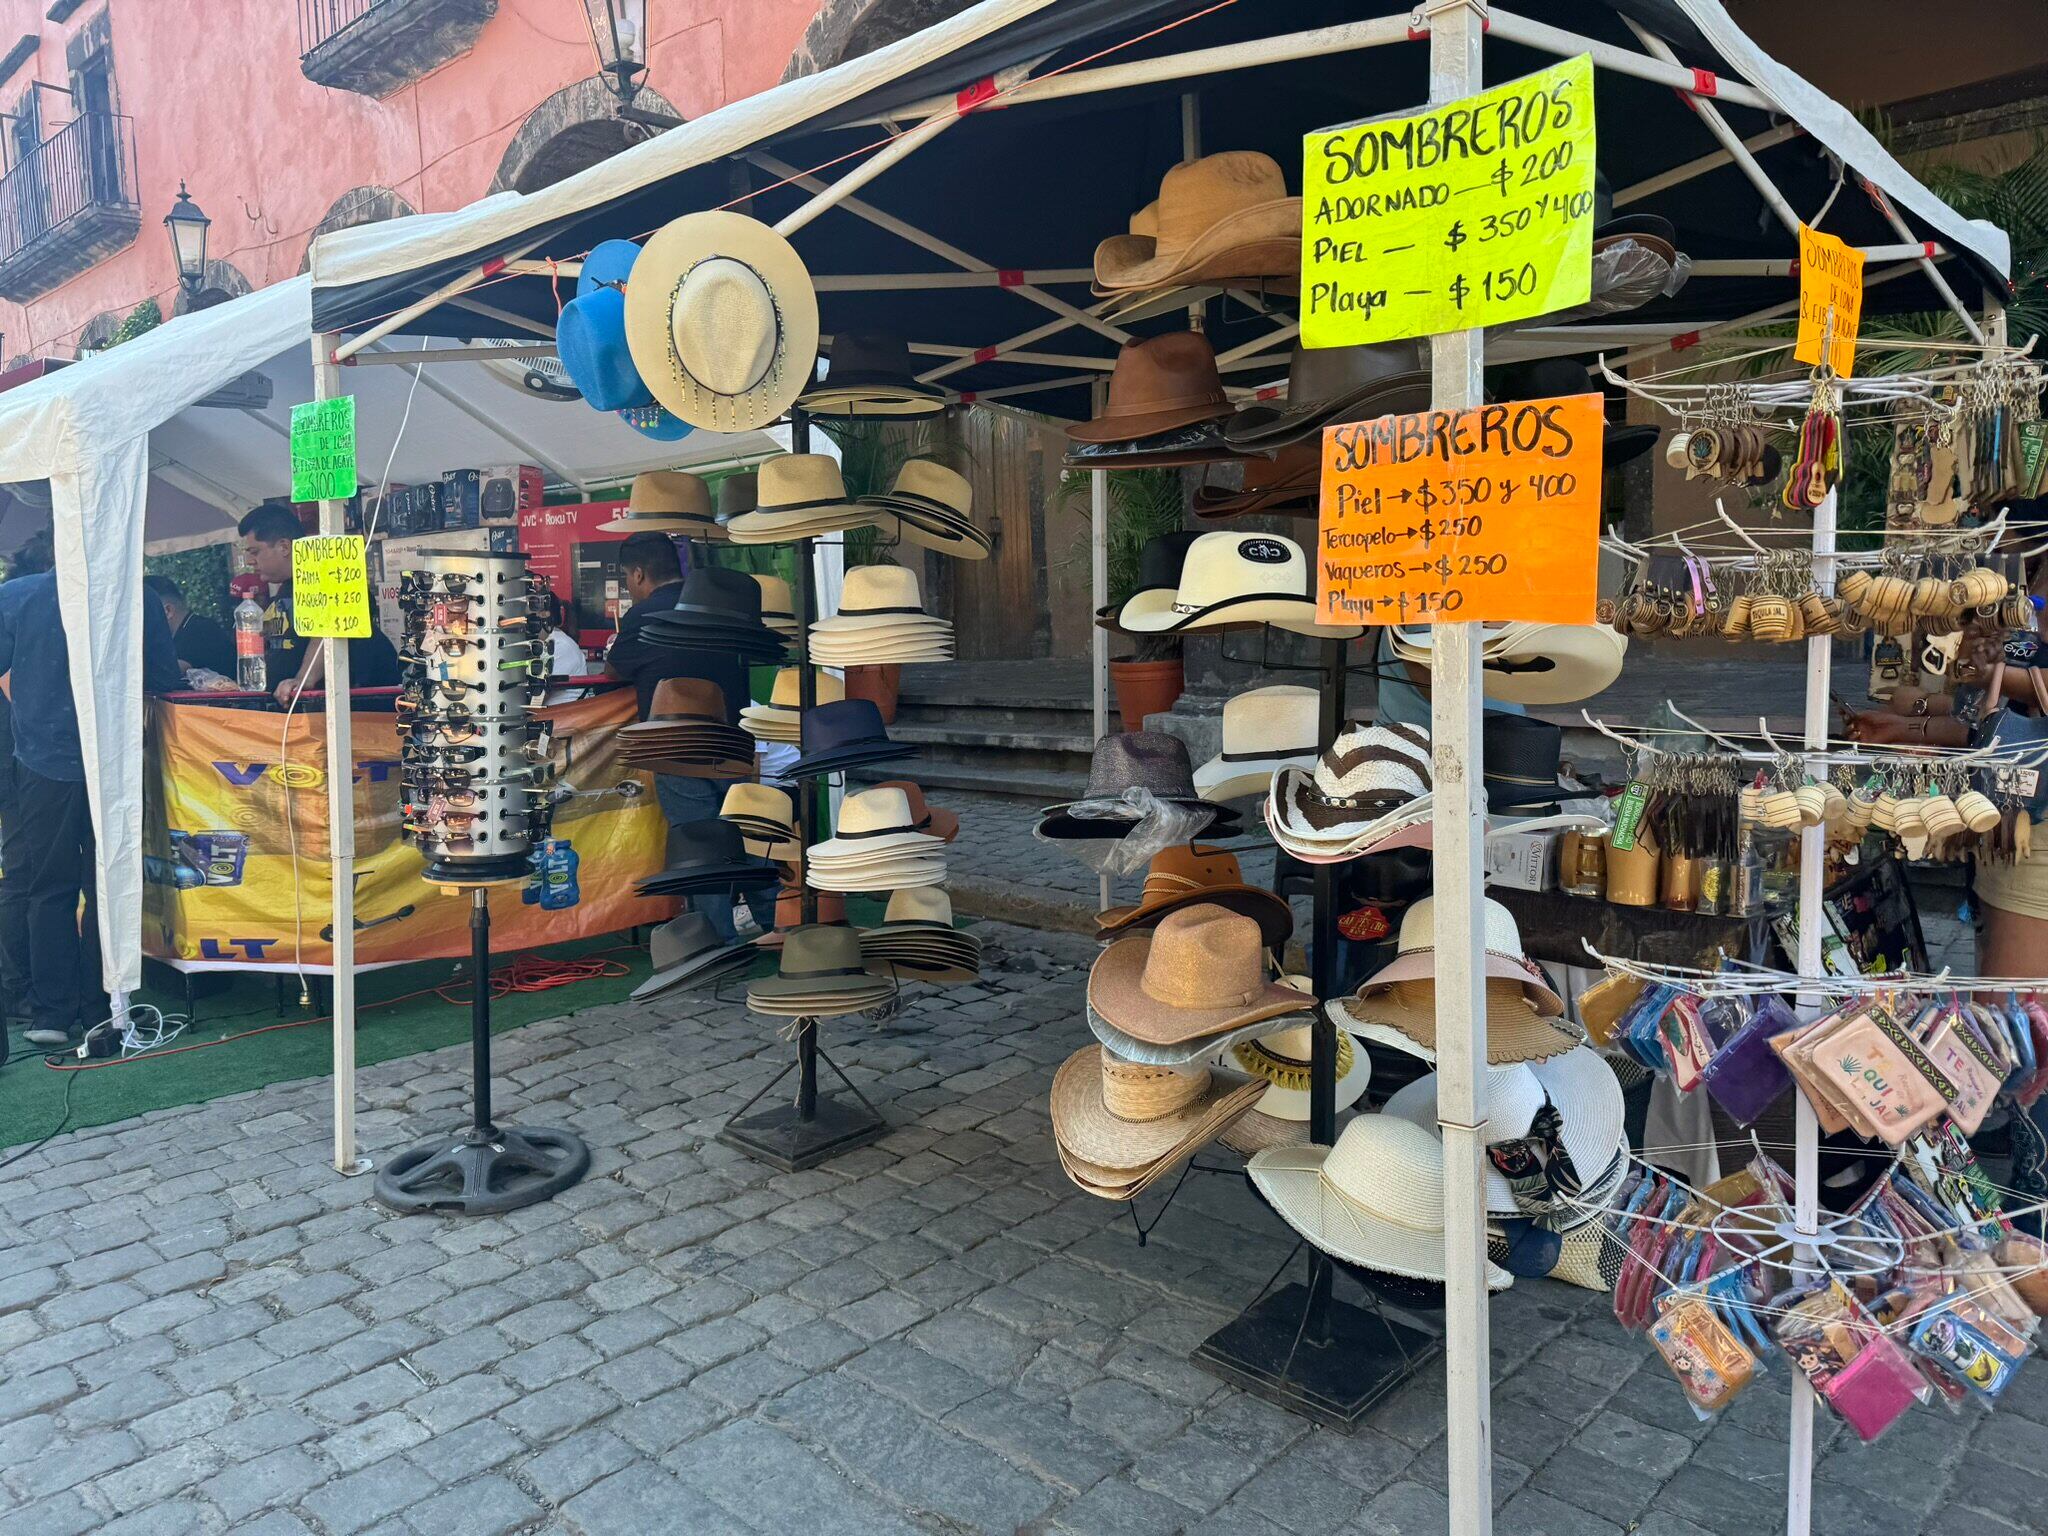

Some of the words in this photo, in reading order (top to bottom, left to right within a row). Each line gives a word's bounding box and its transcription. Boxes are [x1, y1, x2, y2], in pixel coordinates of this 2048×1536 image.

[1323, 79, 1573, 184] SOMBREROS
[1314, 183, 1450, 225] ADORNADO
[1313, 236, 1367, 263] PIEL
[1554, 190, 1594, 224] 400
[1805, 228, 1859, 289] SOMBREROS
[1311, 281, 1387, 321] Playa
[1801, 291, 1808, 319] &
[1812, 304, 1833, 330] FIB
[294, 410, 350, 436] SOMBREROS
[1335, 404, 1573, 473] SOMBREROS
[320, 437, 329, 450] DE
[308, 472, 336, 499] $100
[1336, 483, 1381, 518] Piel
[1500, 479, 1520, 505] y
[1529, 473, 1577, 501] 400
[522, 515, 537, 527] JVC
[566, 511, 578, 524] TV
[294, 537, 359, 565] SOMBREROS
[1322, 527, 1396, 553] Terciopelo
[1325, 562, 1405, 589] Vaqueros
[1328, 590, 1373, 620] Playa
[211, 760, 402, 788] VOT
[207, 844, 238, 884] VOLT
[549, 858, 572, 895] VOLT
